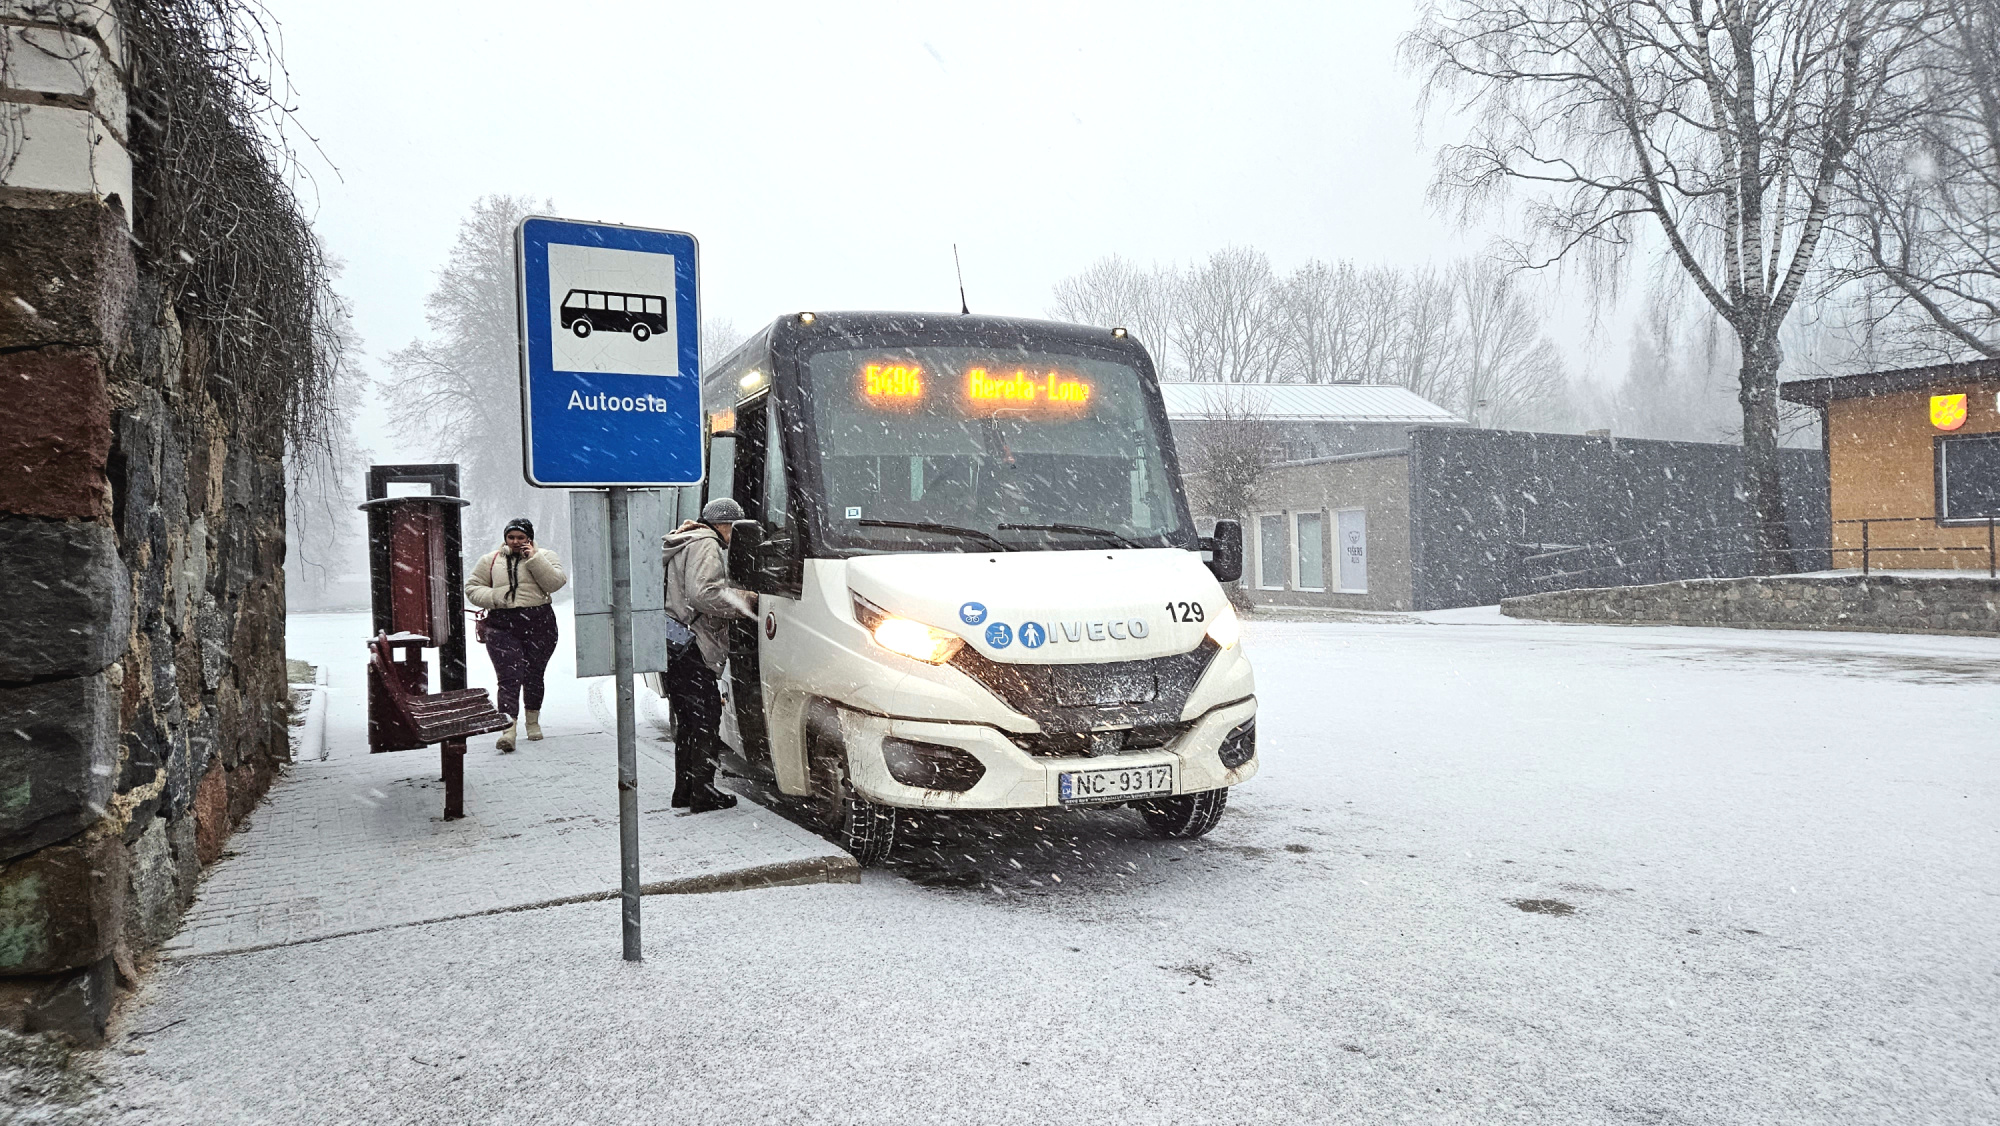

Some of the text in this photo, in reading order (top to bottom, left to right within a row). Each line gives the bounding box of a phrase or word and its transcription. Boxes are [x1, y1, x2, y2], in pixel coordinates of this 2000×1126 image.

[866, 365, 921, 396] 5494
[567, 389, 667, 413] Autoosta
[1165, 601, 1205, 623] 129
[1047, 617, 1150, 644] IVECO
[1077, 768, 1168, 795] NC-9317
